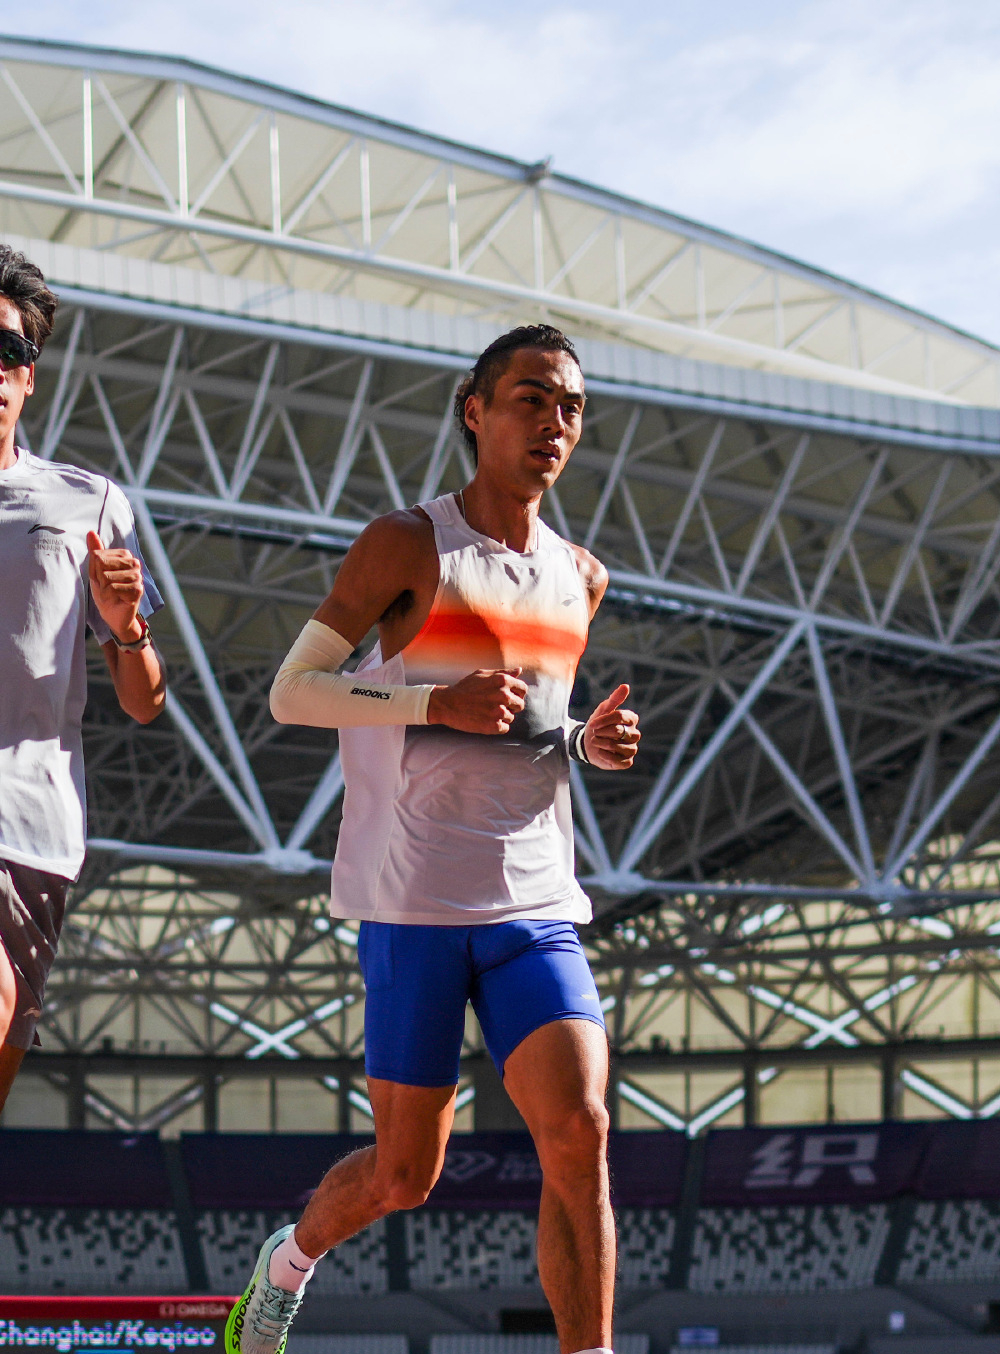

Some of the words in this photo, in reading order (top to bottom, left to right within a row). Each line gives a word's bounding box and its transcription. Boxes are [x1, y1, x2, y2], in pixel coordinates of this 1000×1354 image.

[350, 687, 391, 700] BROOKS
[176, 1303, 229, 1317] OMEGA
[231, 1283, 257, 1352] BROOKS
